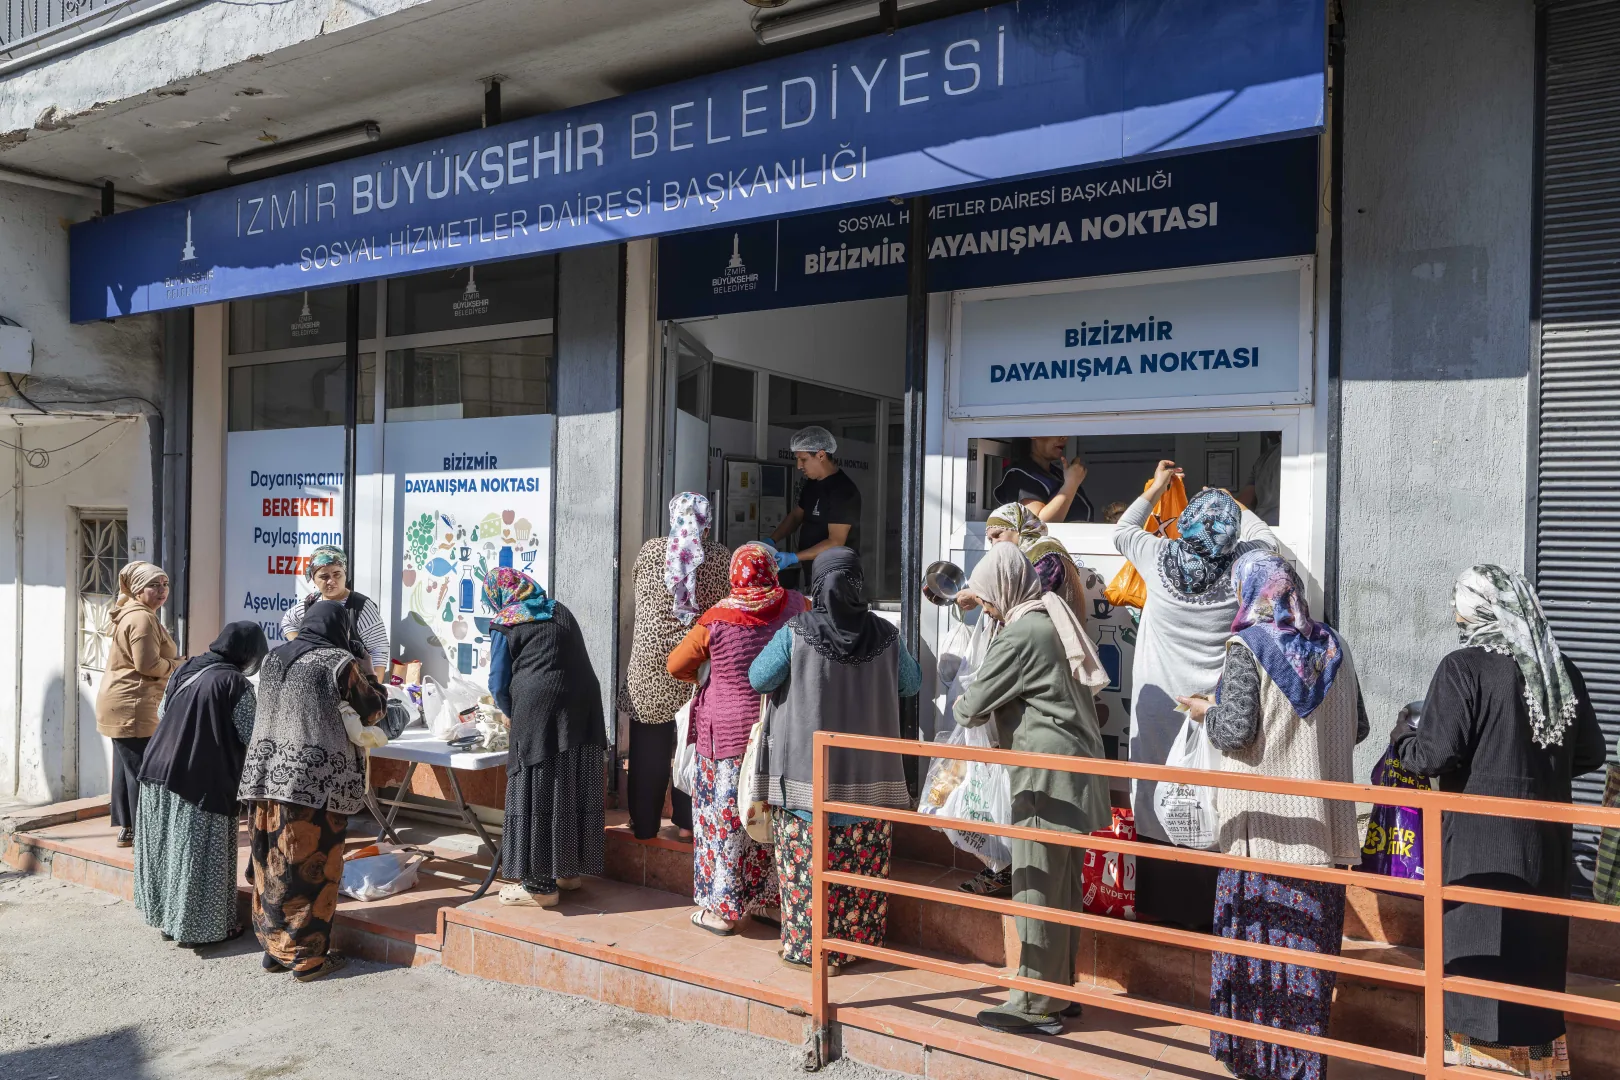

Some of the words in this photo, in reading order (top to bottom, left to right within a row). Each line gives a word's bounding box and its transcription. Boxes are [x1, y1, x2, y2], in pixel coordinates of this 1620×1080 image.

[236, 182, 337, 239] İZMİR
[352, 122, 604, 217] BÜYÜKŞEHİR
[631, 25, 1005, 160] BELEDİYESİ
[299, 236, 383, 272] SOSYAL
[389, 207, 529, 259] HİZMETLER
[537, 179, 652, 232] DAİRESİ
[662, 143, 867, 213] BAŞKANLIĞI
[838, 211, 895, 234] SOSYAL
[990, 188, 1055, 213] DAİRESİ
[1061, 171, 1172, 206] BAŞKANLIĞI
[804, 237, 906, 275] BİZİZMİR
[927, 221, 1073, 260] AYANIŞMA
[1080, 201, 1219, 243] NOKTASI
[712, 273, 759, 287] BÜYÜKŞEHİR
[1064, 315, 1173, 348] BİZİZMİR
[989, 357, 1133, 385] DAYANIŞMA
[1139, 346, 1260, 374] NOKTASI
[443, 451, 498, 471] BİZİZMİR
[405, 479, 478, 496] DAYANIŞMA
[480, 477, 540, 493] NOKTASI
[262, 492, 334, 517] BEREKETİ
[254, 527, 342, 548] Paylaşmanın
[267, 555, 312, 576] LEZZE
